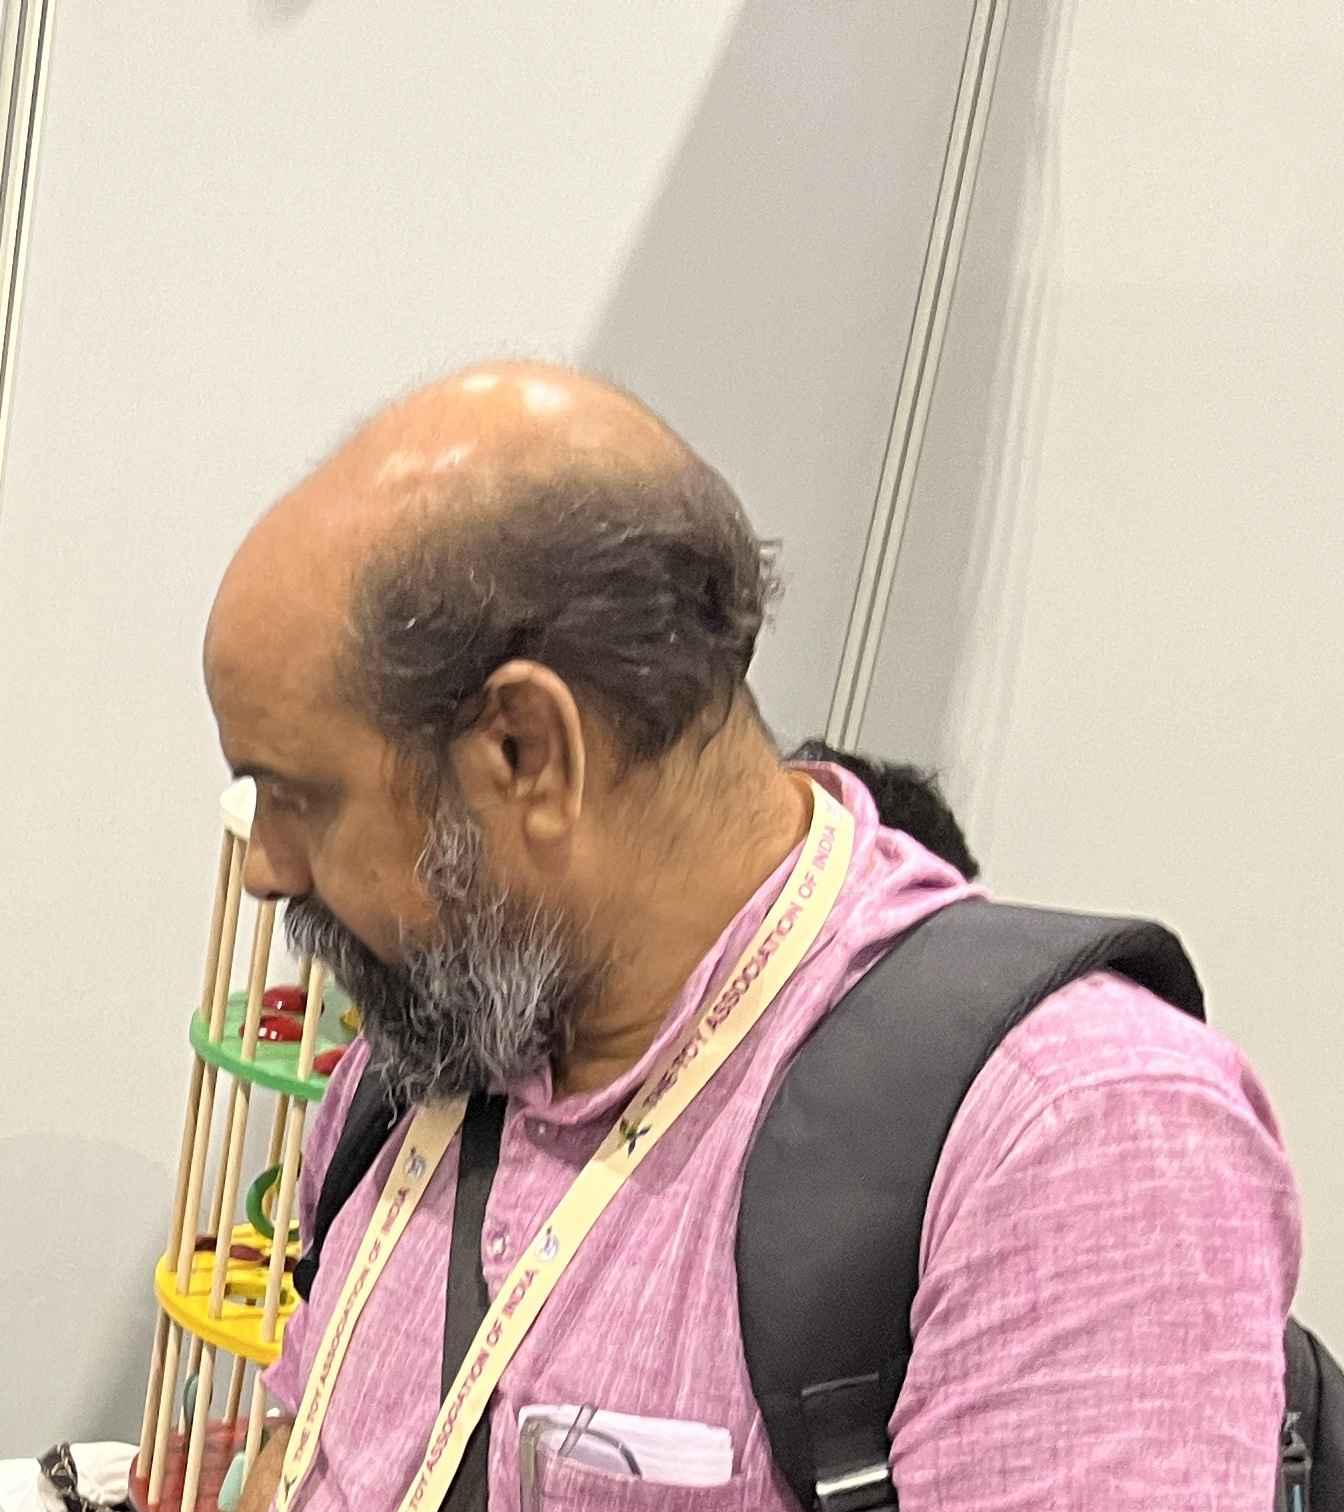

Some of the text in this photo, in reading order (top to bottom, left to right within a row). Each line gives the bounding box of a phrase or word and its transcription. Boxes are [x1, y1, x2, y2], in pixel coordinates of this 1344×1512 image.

[704, 906, 800, 1035] ASSOCIATION
[797, 871, 817, 900] OF
[811, 824, 837, 872] INDIA
[293, 1429, 311, 1461] THE
[319, 1267, 371, 1386] ASSOCIATION
[367, 1237, 382, 1265] OF
[381, 1184, 411, 1233] INDIA
[485, 1319, 503, 1347] OF
[501, 1269, 539, 1319] INDIA
[417, 1348, 490, 1474] ASSOCIATION
[408, 1473, 428, 1512] TOY
